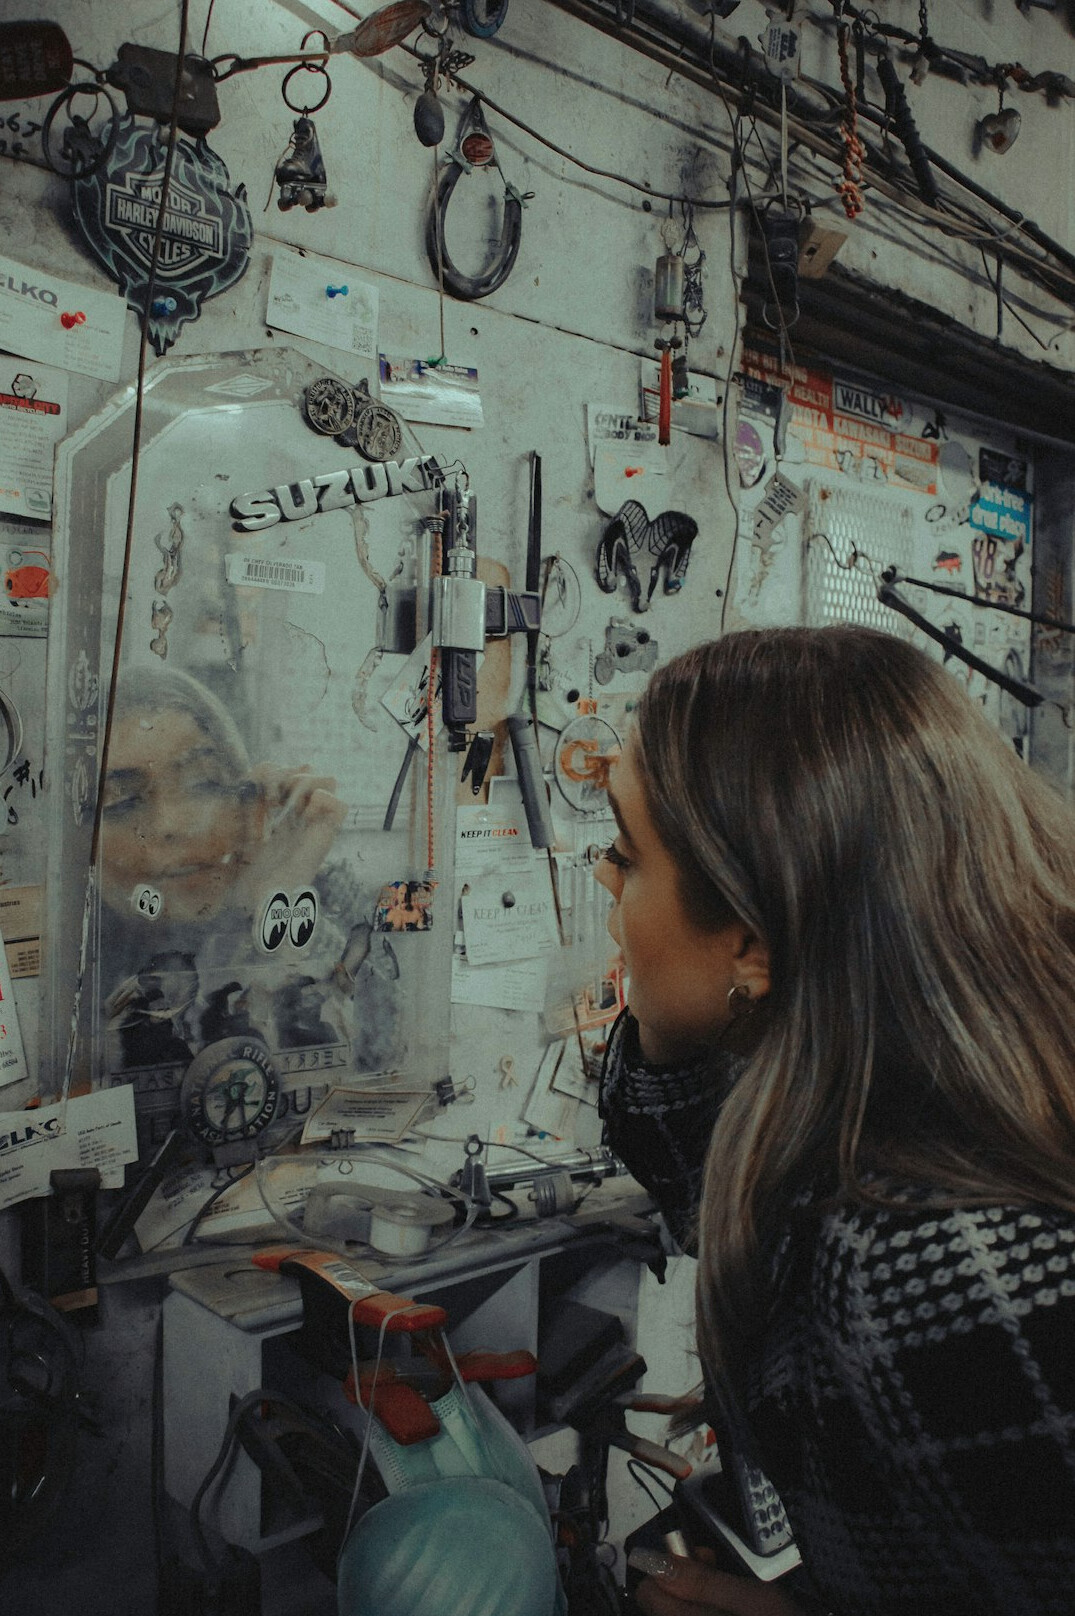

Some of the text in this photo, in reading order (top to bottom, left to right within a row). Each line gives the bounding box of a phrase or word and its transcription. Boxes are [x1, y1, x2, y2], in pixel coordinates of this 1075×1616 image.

[141, 185, 192, 215] MOTOR
[116, 198, 214, 246] HARLEY DAVIDSON
[840, 387, 887, 421] WALLY
[833, 415, 891, 449] KAWASAKI
[229, 455, 437, 533] SUZUKI
[460, 828, 519, 839] KEEP IT CLEAN
[270, 906, 310, 920] MOON
[473, 907, 501, 920] KEEP
[516, 902, 548, 916] CLEAN
[242, 1046, 272, 1076] RIFLE
